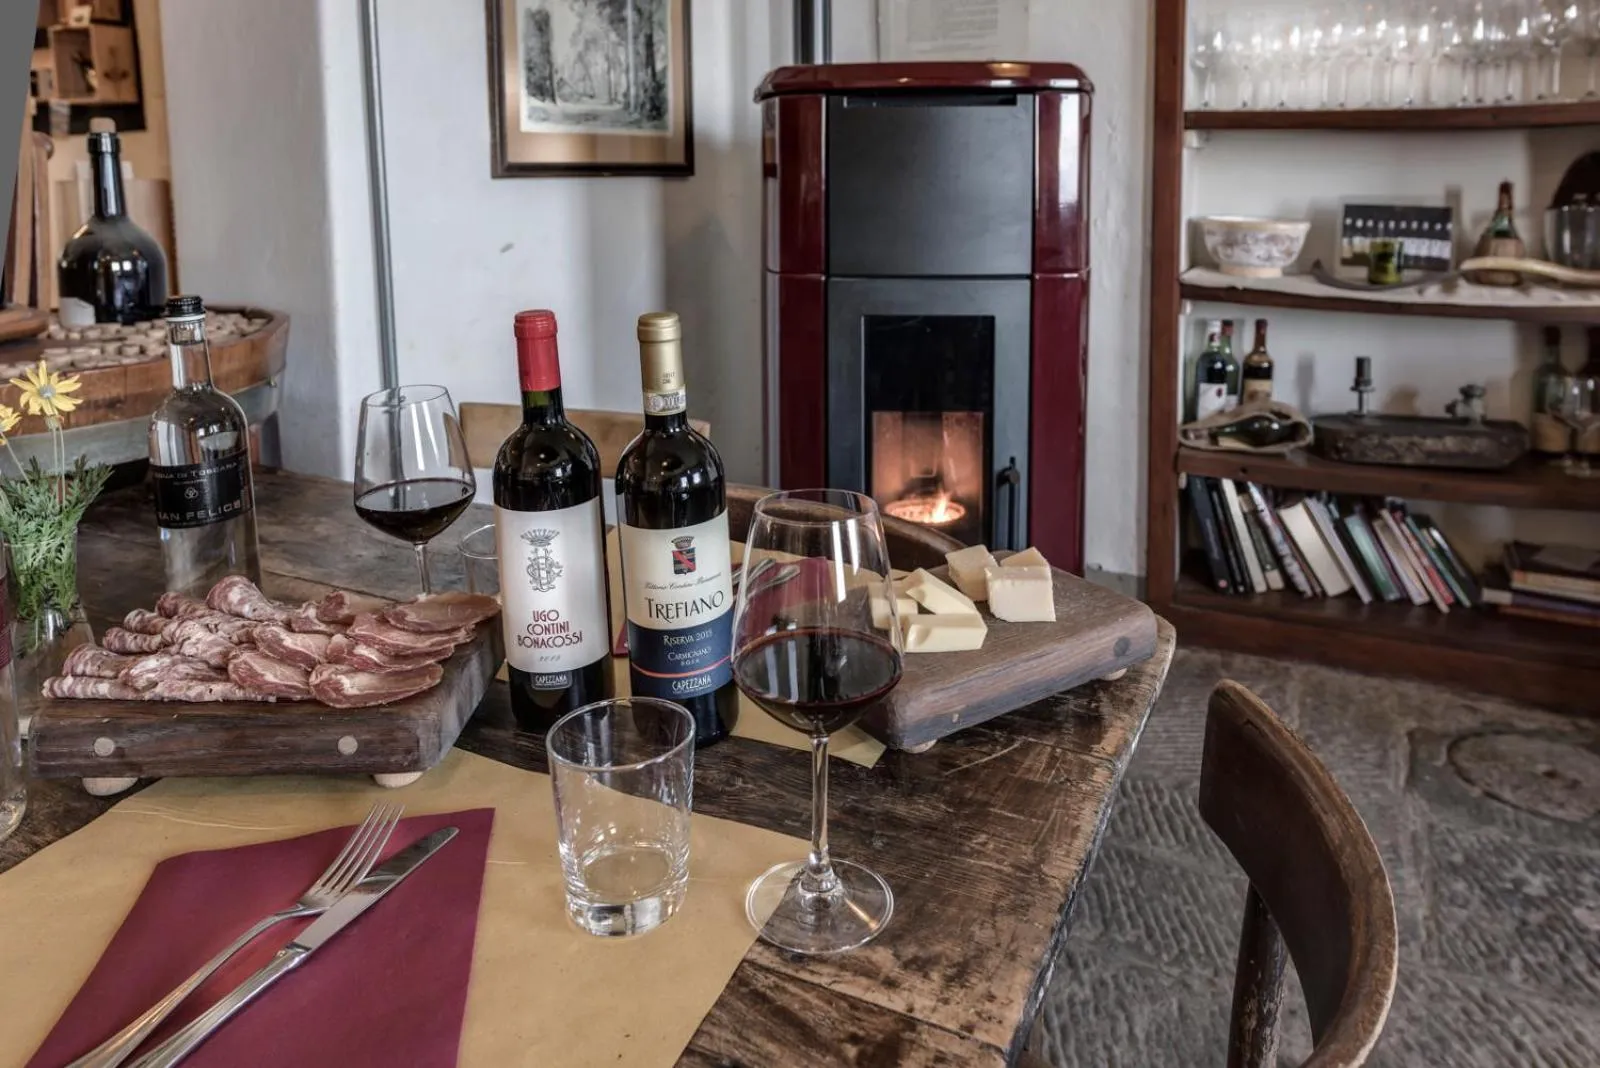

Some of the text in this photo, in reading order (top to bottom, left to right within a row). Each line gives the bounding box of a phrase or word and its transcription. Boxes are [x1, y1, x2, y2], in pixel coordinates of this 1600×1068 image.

[644, 590, 725, 624] TREFIANO
[532, 609, 560, 623] UGO
[526, 620, 570, 636] CONTINI
[517, 631, 583, 649] BONACOSSI
[663, 634, 695, 649] RISERVA
[534, 674, 567, 685] CAPEZZANA
[671, 675, 712, 691] CAPEZZANA
